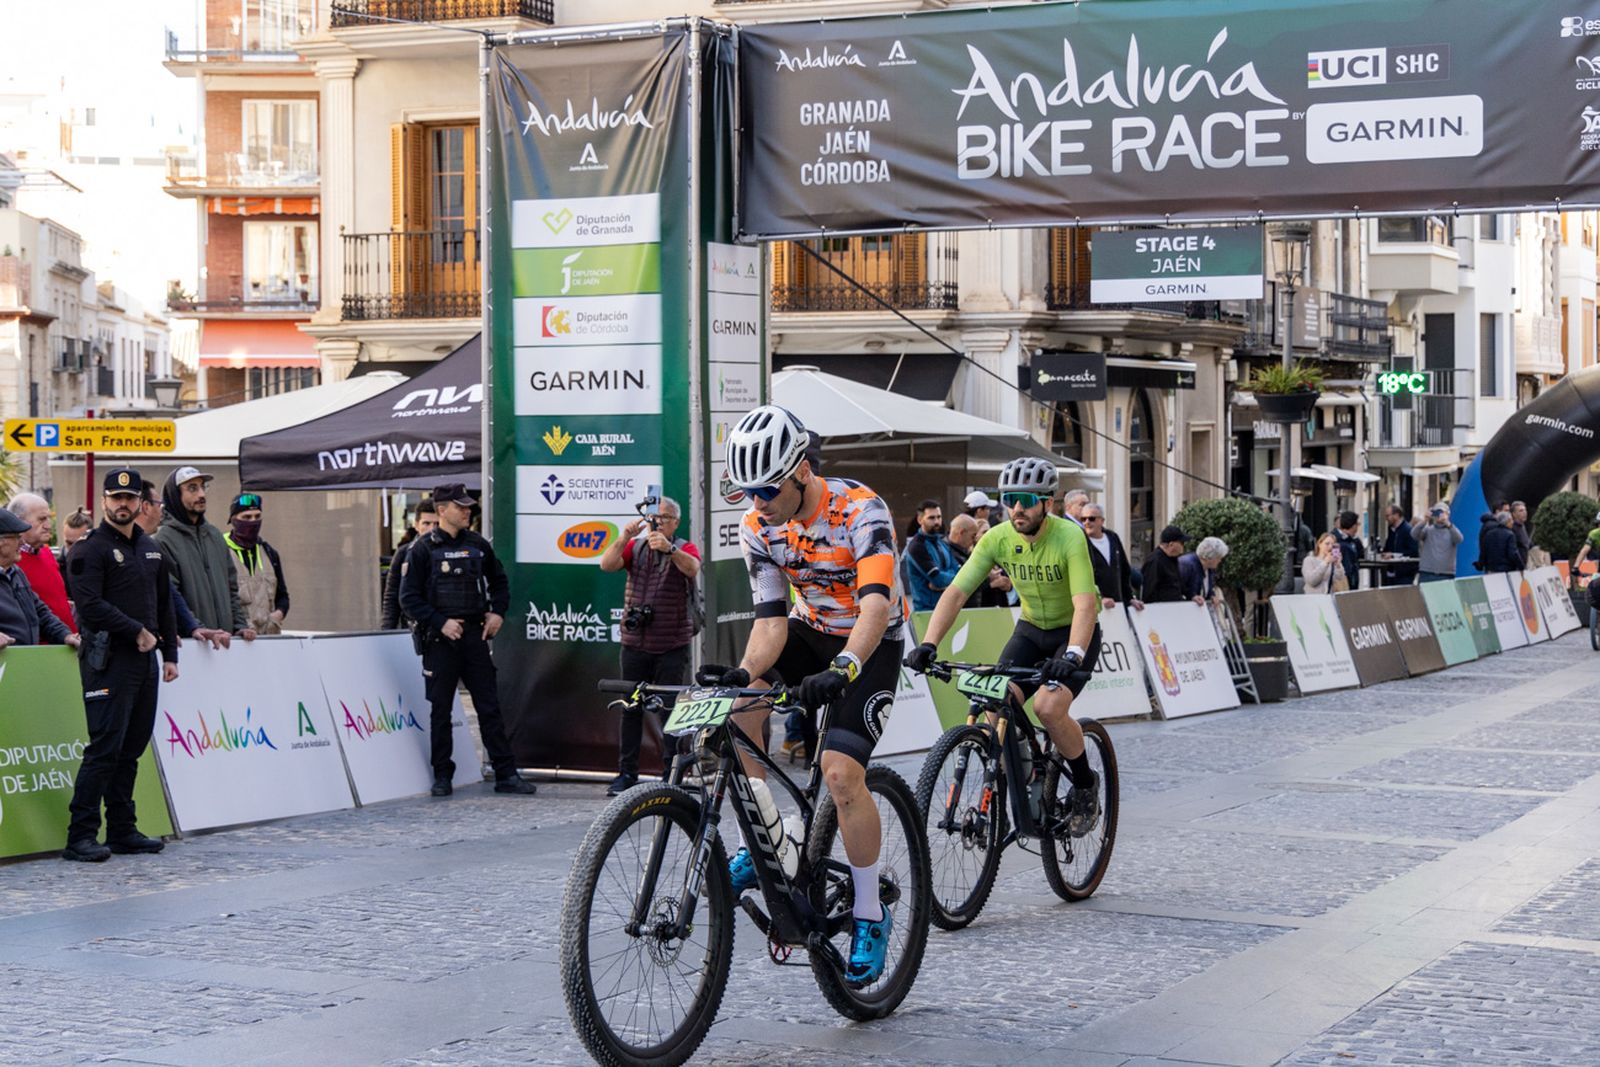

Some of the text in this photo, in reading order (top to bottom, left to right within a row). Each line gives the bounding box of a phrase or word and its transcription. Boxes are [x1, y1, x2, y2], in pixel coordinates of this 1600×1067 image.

[775, 44, 866, 72] Andalucía
[1321, 55, 1380, 81] UCI
[1395, 53, 1439, 74] SHC
[951, 26, 1288, 121] Andalucía
[522, 95, 653, 136] Andalucía
[799, 99, 891, 127] GRANADA
[1292, 112, 1305, 120] BY
[819, 127, 870, 155] JAÉN
[957, 108, 1290, 180] BIKE RACE
[800, 158, 891, 186] CÓRDOBA
[576, 213, 631, 226] Diputación
[576, 224, 634, 236] de Granada
[1135, 235, 1216, 253] STAGE 4
[1150, 255, 1200, 273] JAÉN
[1145, 284, 1206, 295] GARMIN
[576, 322, 629, 334] de Córdoba
[577, 311, 628, 323] Diputación
[713, 319, 757, 336] GARMIN
[66, 424, 171, 433] aparcamiento municipal
[1525, 413, 1594, 438] garmin.com
[65, 436, 171, 447] San Francisco
[575, 433, 634, 443] CAJA RURAL
[318, 441, 466, 471] northwave
[592, 445, 616, 456] JAÉN
[568, 478, 634, 488] SCIENTIFFIC
[719, 524, 740, 547] SE
[526, 601, 607, 626] Andalucía
[526, 623, 608, 642] BIKE RACE
[1350, 623, 1392, 650] GARMIN
[1395, 616, 1432, 641] GARMIN
[1175, 648, 1219, 664] AYUNTAMIENTO
[1180, 671, 1190, 683] DE
[339, 694, 424, 741] Andalucía
[675, 701, 722, 724] 2221
[164, 706, 278, 759] Andalucía
[0, 739, 90, 767] DIPUTACIÓ
[3, 770, 74, 795] DE JAÉN
[631, 797, 671, 816] MAXXIS
